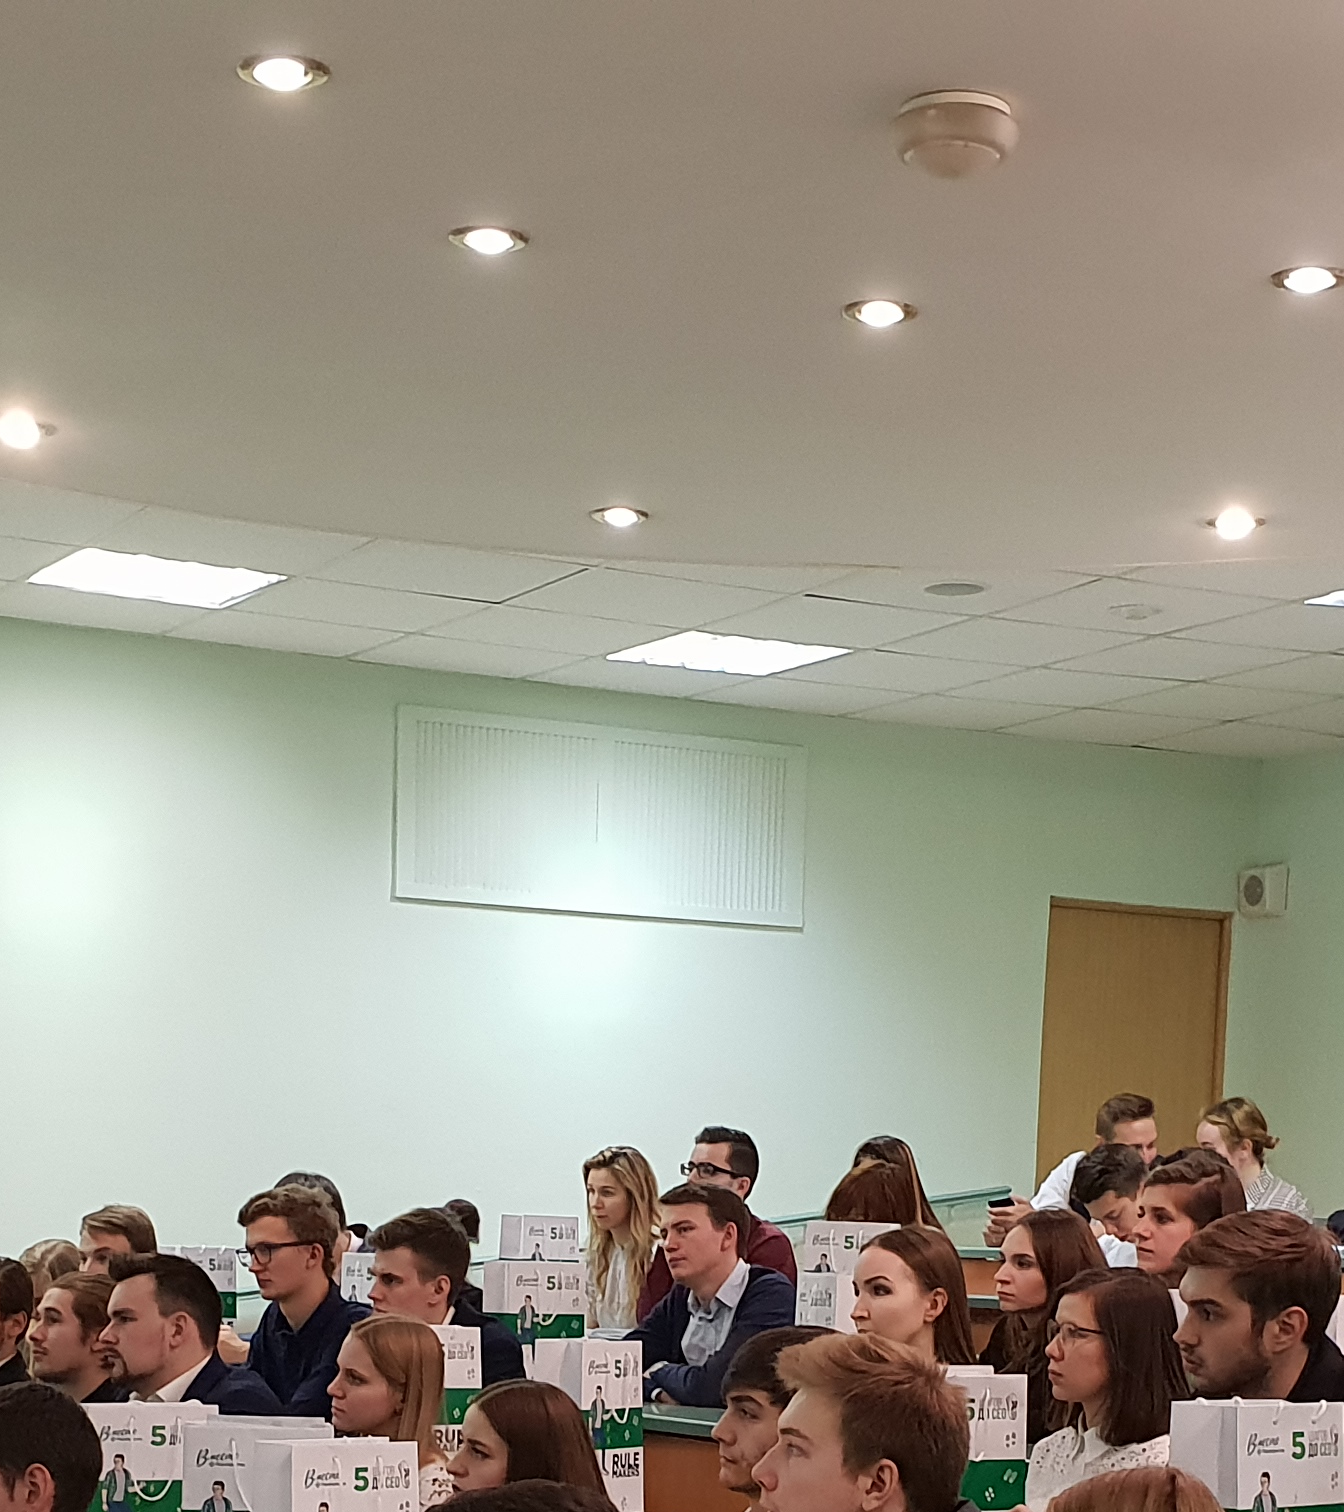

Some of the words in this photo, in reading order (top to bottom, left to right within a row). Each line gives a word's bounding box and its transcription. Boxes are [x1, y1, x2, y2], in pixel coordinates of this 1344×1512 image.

[550, 1227, 558, 1240] 5
[843, 1235, 854, 1249] 5
[546, 1275, 556, 1291] 5
[614, 1359, 622, 1379] 5
[150, 1425, 167, 1446] 5
[1291, 1431, 1306, 1459] 5
[612, 1452, 639, 1470] RULE
[354, 1467, 369, 1491] 5
